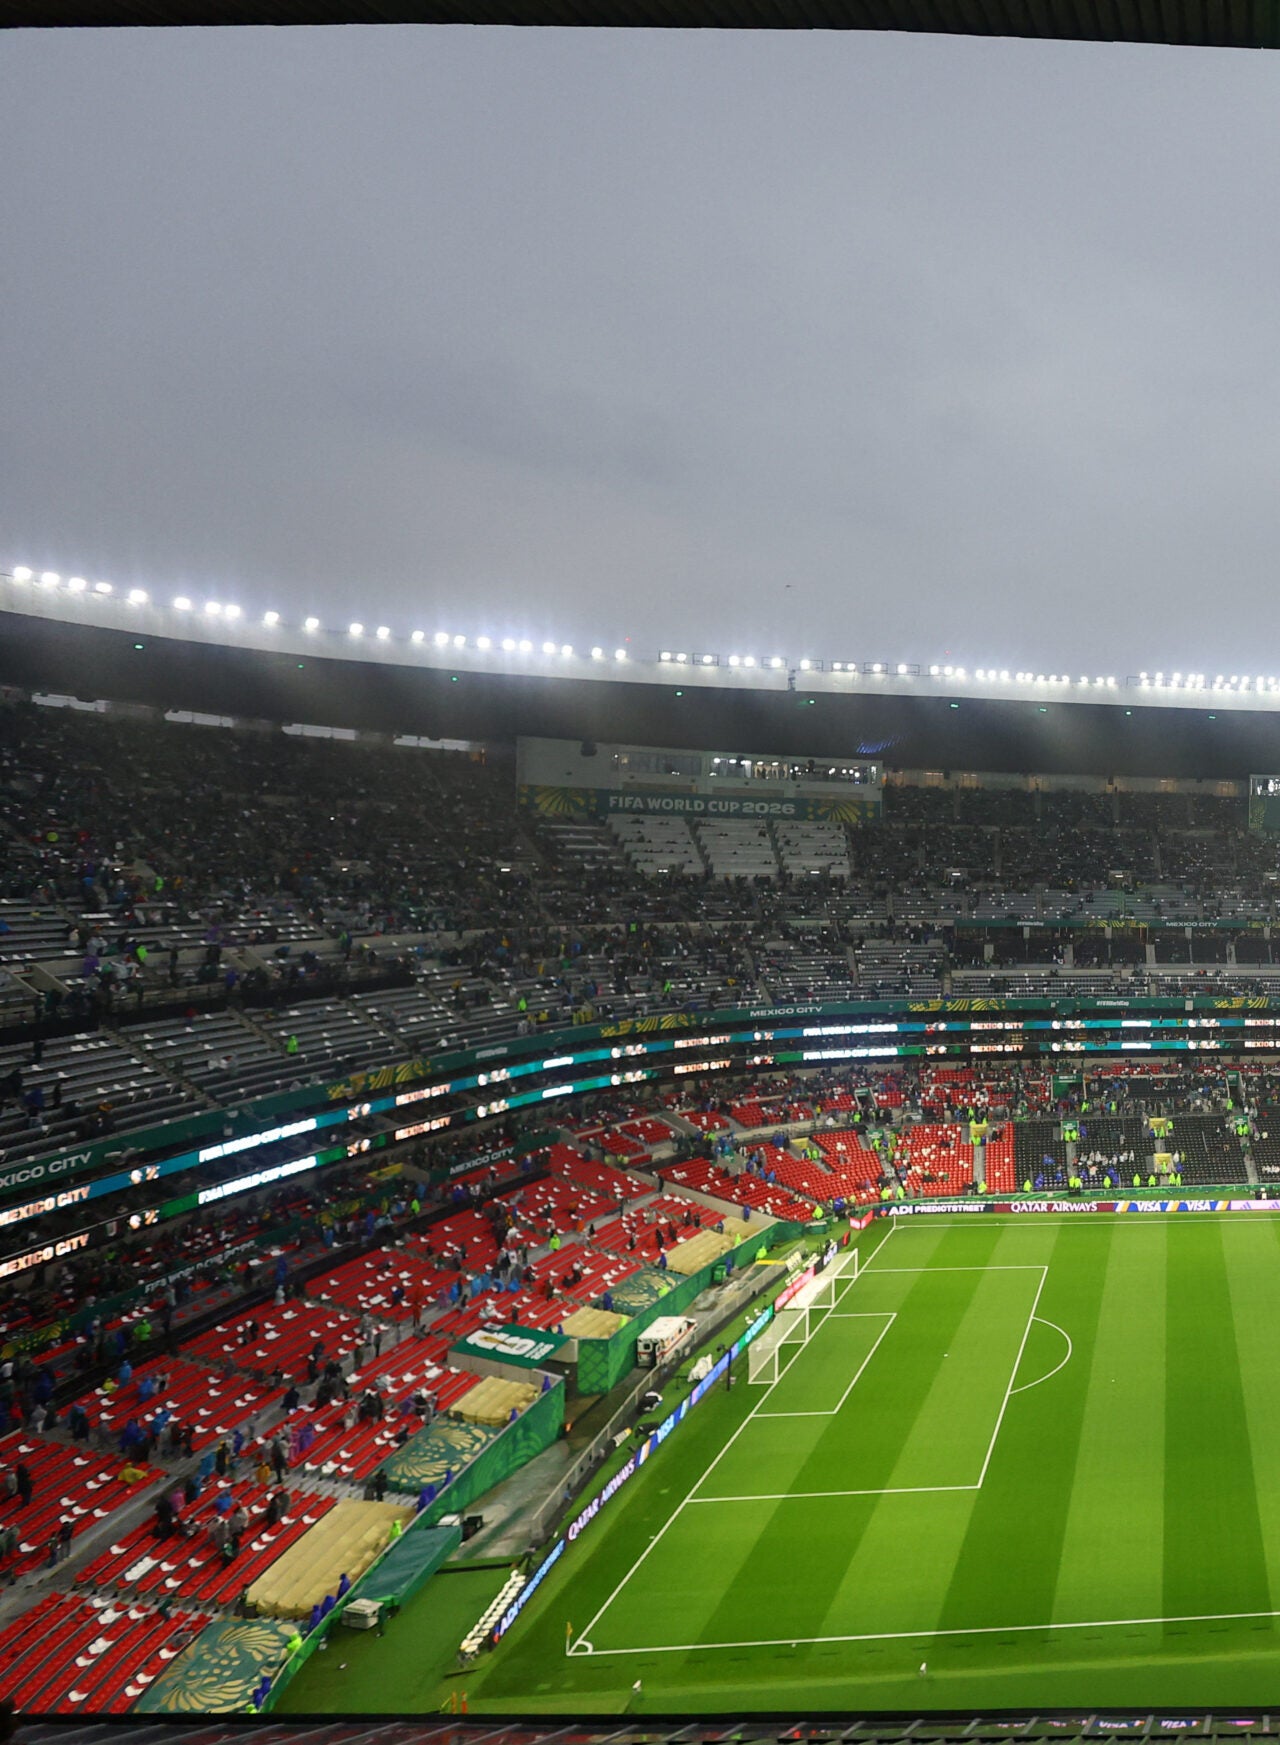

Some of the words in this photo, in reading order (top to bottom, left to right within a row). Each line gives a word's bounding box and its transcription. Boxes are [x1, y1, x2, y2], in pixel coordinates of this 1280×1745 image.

[609, 796, 644, 809] FIFA
[647, 798, 704, 812] WORLD
[708, 801, 740, 813] CUP
[742, 802, 795, 815] 2026
[750, 1008, 794, 1017] MEXICO
[796, 1006, 822, 1014] CITY
[48, 1152, 91, 1173] CITY
[450, 1154, 490, 1175] MEXICO
[491, 1147, 514, 1160] CITY
[57, 1186, 91, 1207] CITY
[1186, 1201, 1211, 1211] VISA
[889, 1205, 913, 1216] ADI
[914, 1205, 985, 1213] PREDICTSTREET
[1010, 1202, 1048, 1213] QATAR
[1051, 1202, 1097, 1212] AIRWAYS
[1137, 1201, 1161, 1212] VISA
[55, 1233, 90, 1256] CITY
[568, 1498, 600, 1541] QATAR
[601, 1458, 635, 1502] AIRWAYS
